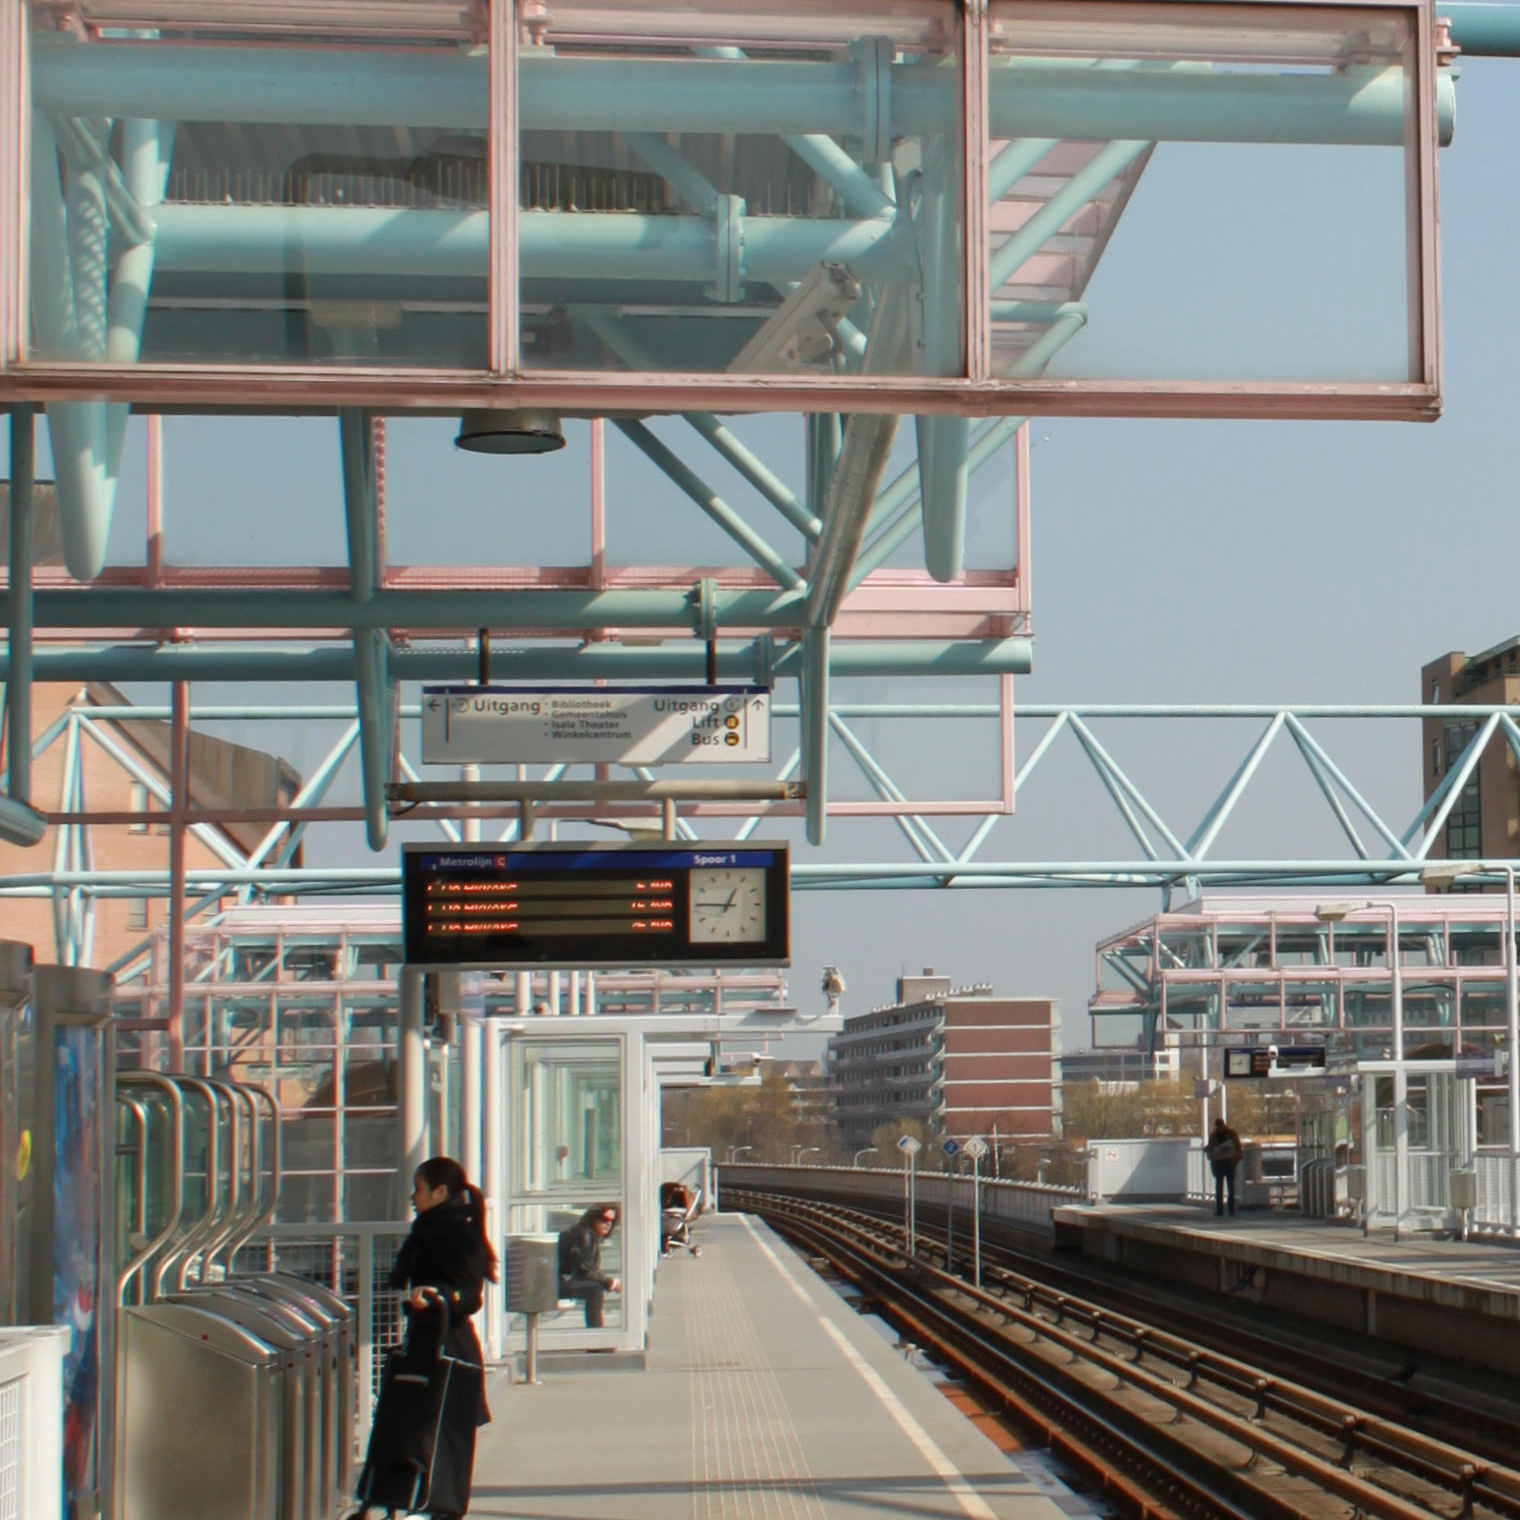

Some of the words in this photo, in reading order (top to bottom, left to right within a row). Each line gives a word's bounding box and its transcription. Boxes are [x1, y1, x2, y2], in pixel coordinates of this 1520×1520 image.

[474, 699, 541, 715] Uitgang
[552, 699, 612, 709] Bibliotheek
[654, 699, 720, 715] Uitgang
[552, 710, 628, 719] Gemeentehuis
[552, 720, 576, 729] Isala
[579, 720, 620, 729] Theater
[692, 715, 720, 729] Lift
[552, 730, 632, 739] Winkelcentrum
[691, 732, 720, 746] Bus
[440, 856, 492, 868] Metrolijn
[693, 854, 726, 866] Spoor
